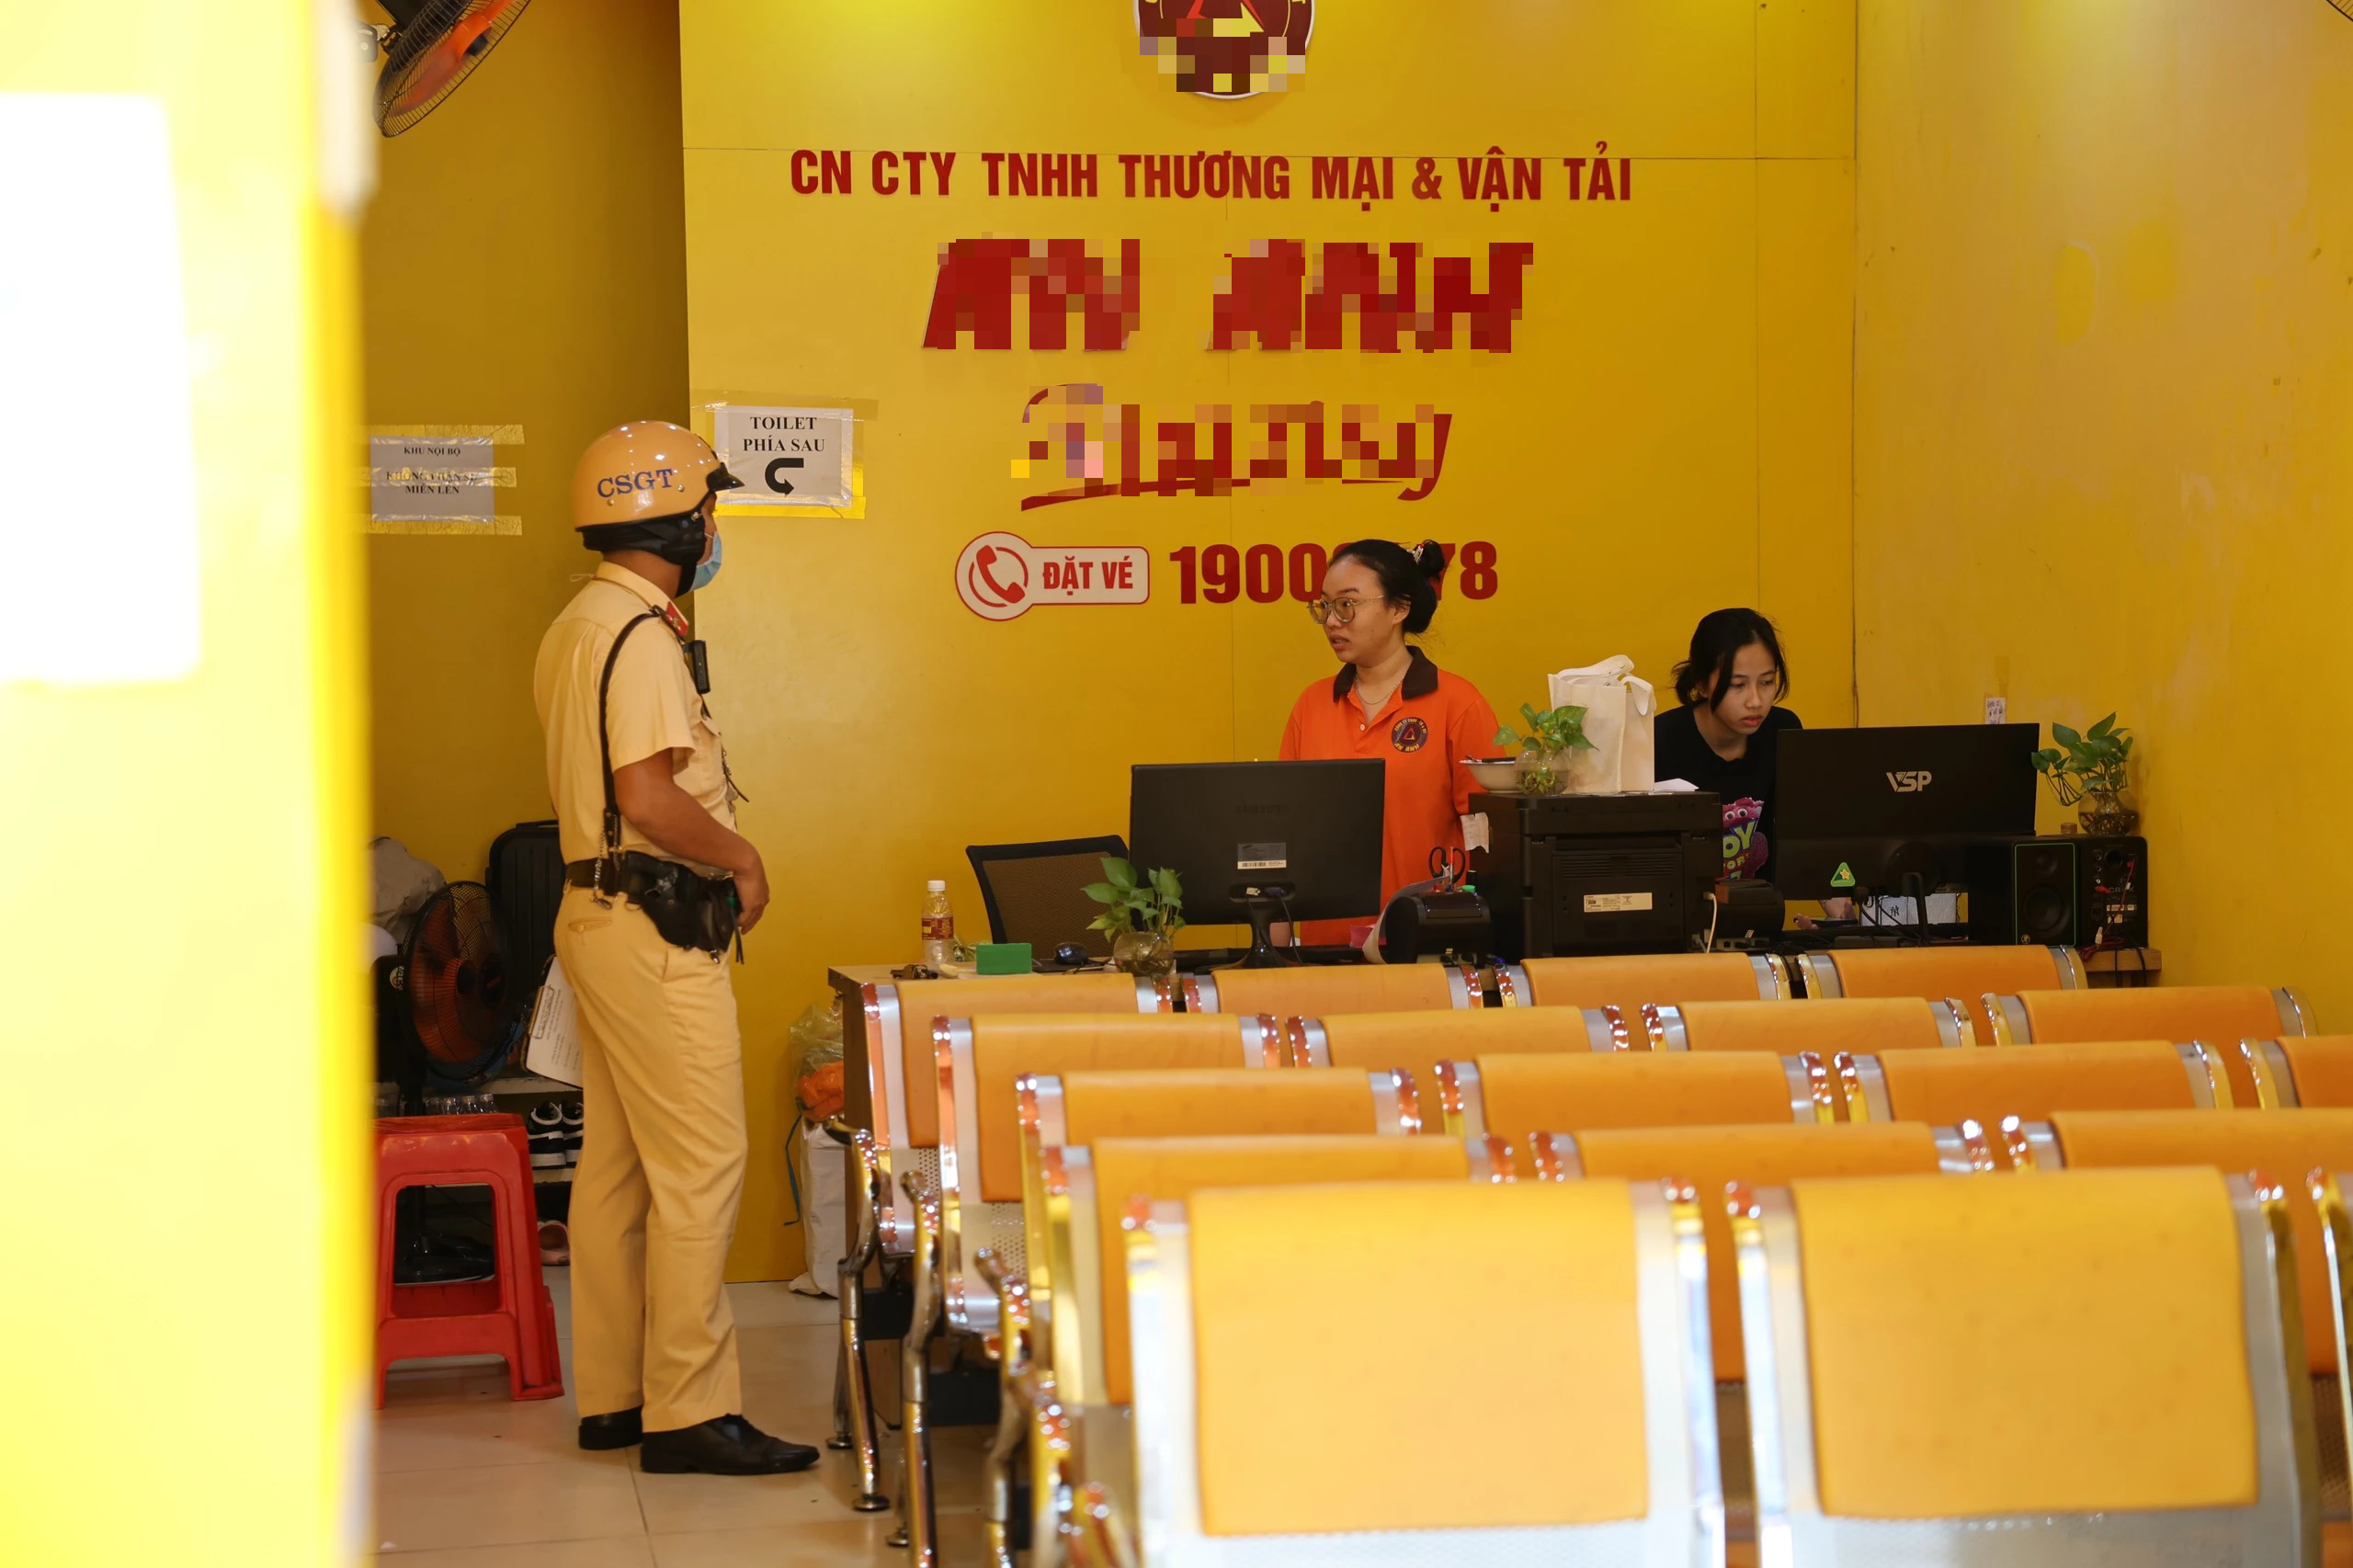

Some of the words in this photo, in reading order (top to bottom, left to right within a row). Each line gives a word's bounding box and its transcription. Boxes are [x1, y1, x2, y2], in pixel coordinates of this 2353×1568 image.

[791, 150, 851, 195] CN
[871, 151, 956, 196] CTY
[981, 153, 1097, 198] TNHH
[1118, 150, 1290, 199] THƯƠNG
[1312, 156, 1393, 211] MẠI
[1412, 157, 1442, 199] &
[1457, 145, 1541, 212] VẬN
[1563, 141, 1631, 200] TẢI
[750, 416, 817, 430] TOILET
[404, 446, 425, 455] KHU
[743, 435, 786, 452] PHÍA
[790, 438, 825, 452] SAU
[597, 468, 674, 498] CSGT
[1042, 556, 1093, 596] ĐẶT
[1101, 556, 1133, 589] VÉ
[1885, 770, 1932, 793] VSP
